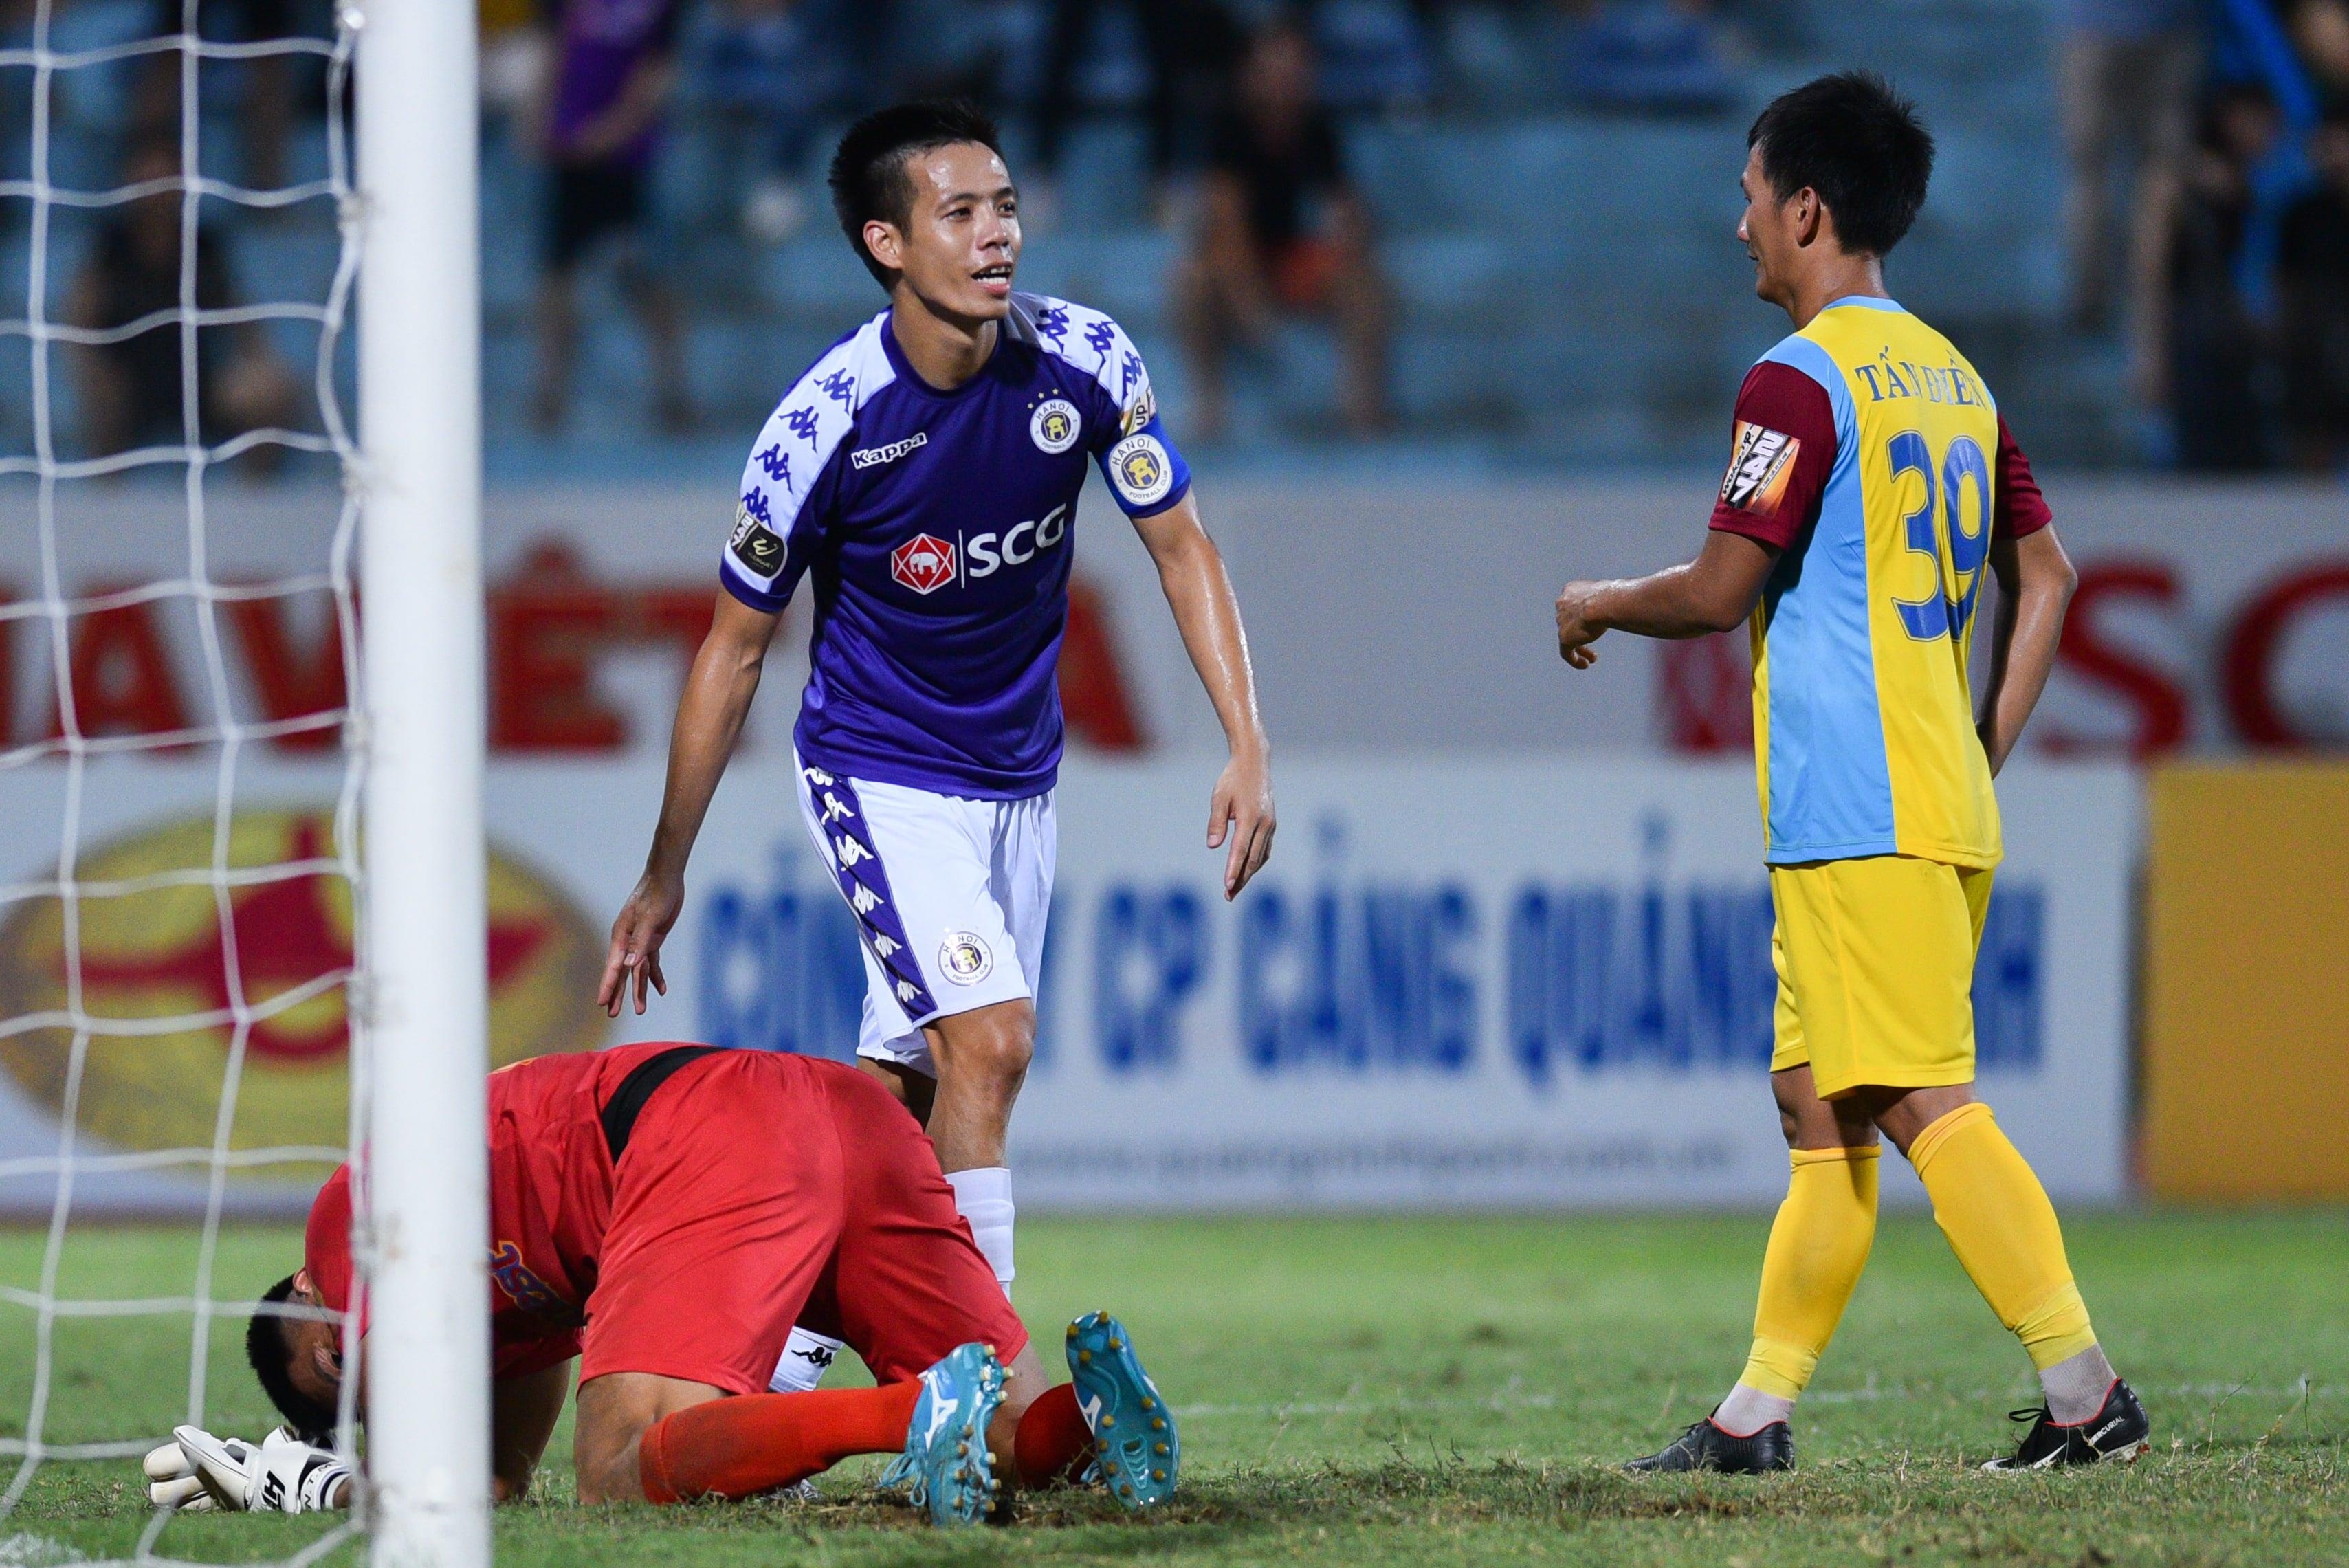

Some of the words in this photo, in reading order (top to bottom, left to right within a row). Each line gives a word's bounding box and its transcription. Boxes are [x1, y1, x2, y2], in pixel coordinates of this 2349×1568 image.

[1036, 402, 1070, 420] HANOI
[851, 432, 927, 469] Kappa
[1112, 438, 1150, 466] HANOI
[1730, 429, 1785, 502] 247
[1129, 487, 1161, 500] FOOTBALL
[967, 503, 1066, 578] SCG
[1886, 429, 1990, 643] 39
[943, 935, 978, 953] HNOI
